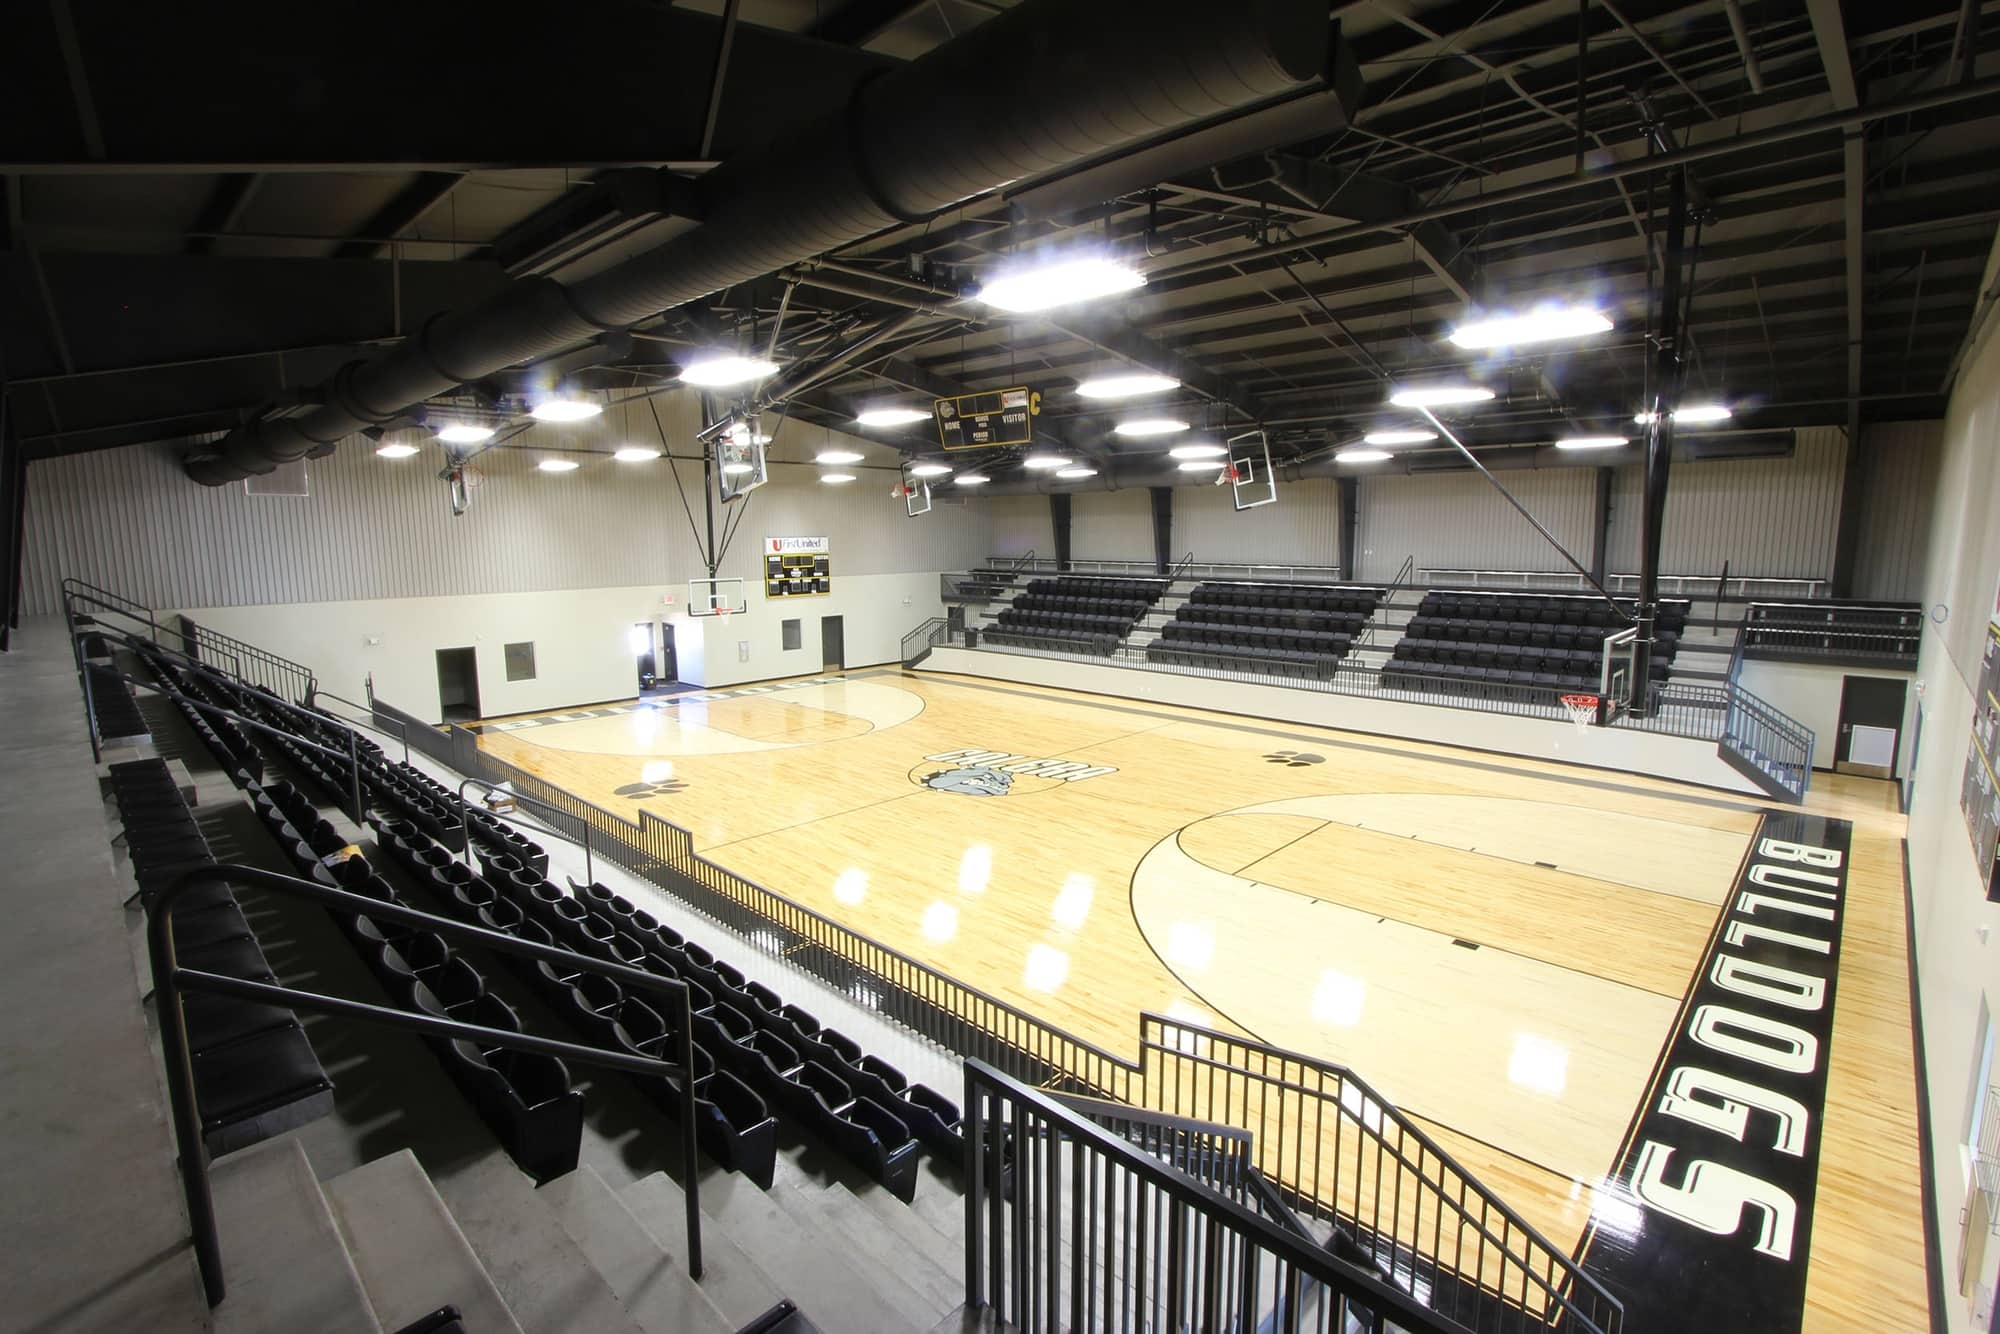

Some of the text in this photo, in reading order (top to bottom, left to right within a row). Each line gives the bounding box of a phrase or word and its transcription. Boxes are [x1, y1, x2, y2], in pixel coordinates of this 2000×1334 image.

[944, 421, 961, 431] HOME
[1002, 413, 1026, 424] VISITOR
[923, 748, 1119, 783] CALERA
[1629, 838, 1842, 1262] BULLDOGS
